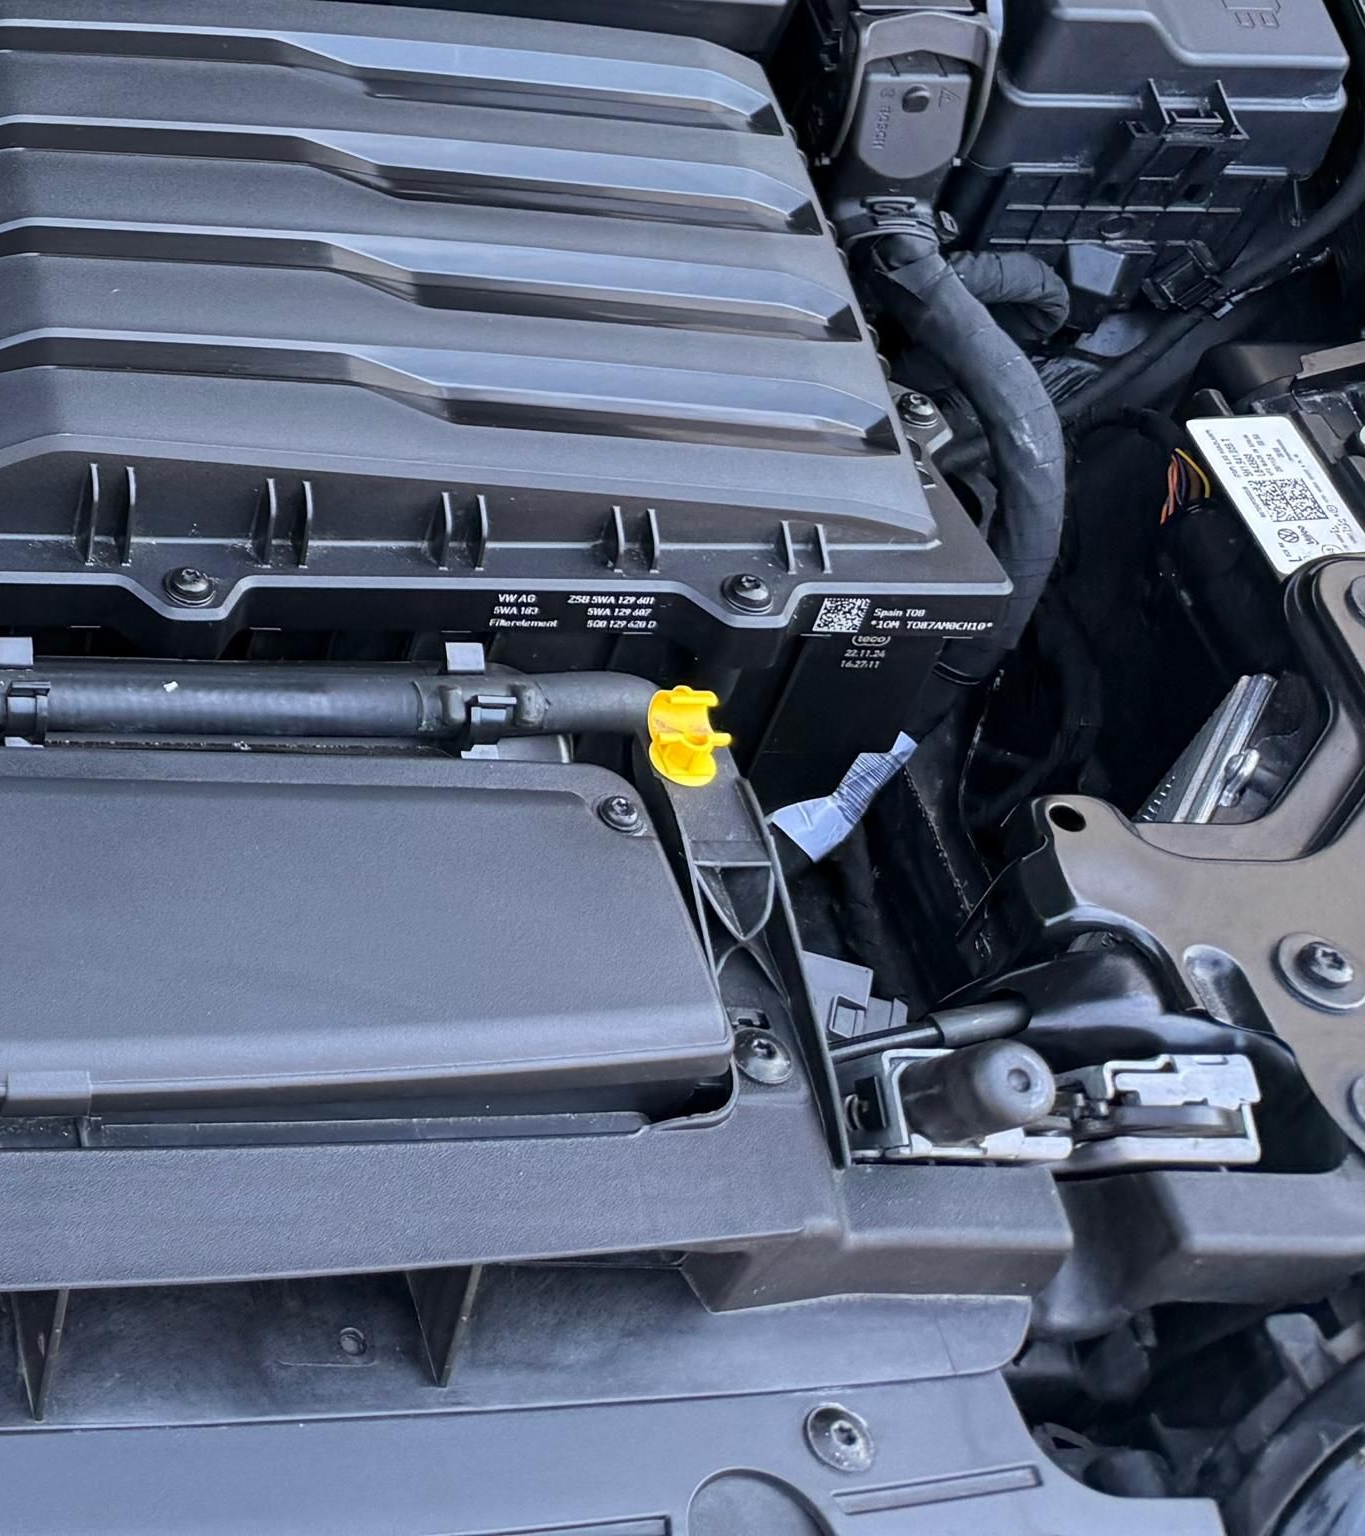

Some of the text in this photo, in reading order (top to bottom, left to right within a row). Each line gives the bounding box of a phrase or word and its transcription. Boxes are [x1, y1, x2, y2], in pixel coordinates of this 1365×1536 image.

[498, 594, 537, 603] VW AG
[591, 596, 615, 604] 5WA
[618, 596, 636, 604] 129
[614, 608, 632, 616] 129
[873, 608, 902, 618] Spain
[609, 620, 627, 628] 129
